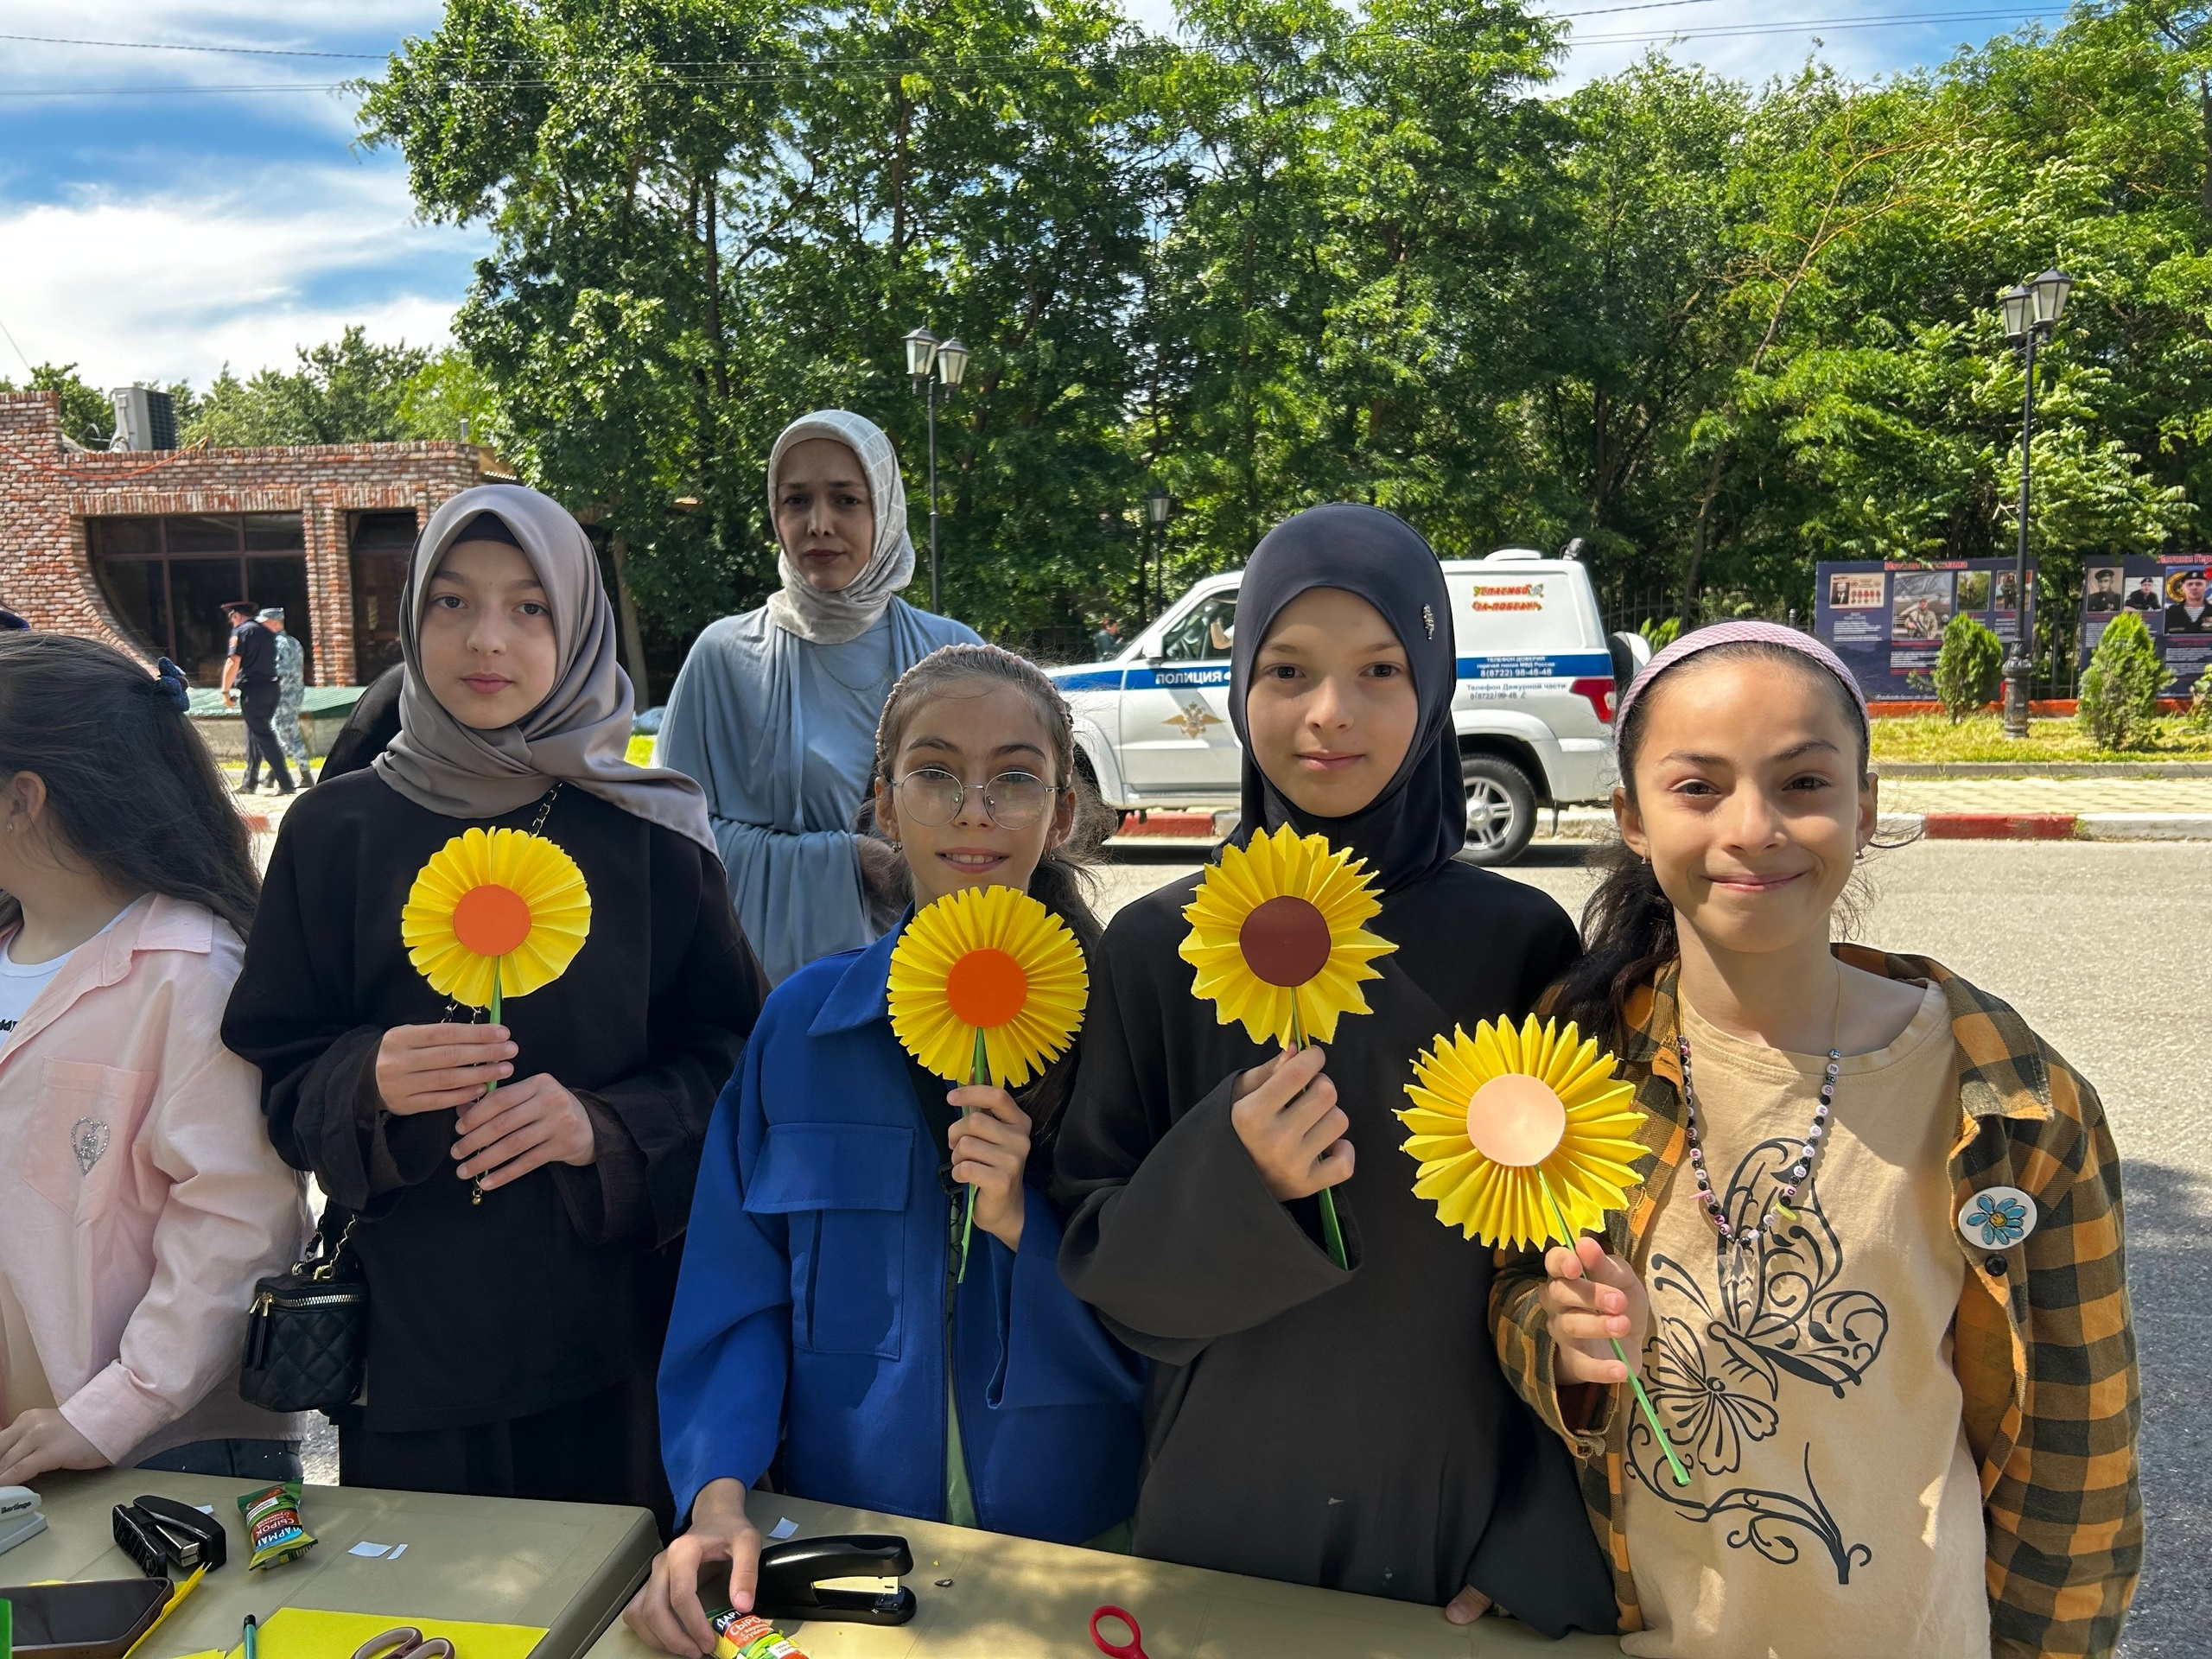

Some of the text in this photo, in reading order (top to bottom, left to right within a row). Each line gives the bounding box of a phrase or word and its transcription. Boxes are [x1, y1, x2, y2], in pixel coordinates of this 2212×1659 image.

[1155, 670, 1223, 684] ПОЛИЦИЯ
[1480, 669, 1513, 678] 8(8722)
[1503, 683, 1542, 693] Дежурной
[256, 1518, 295, 1536] СЫРОК
